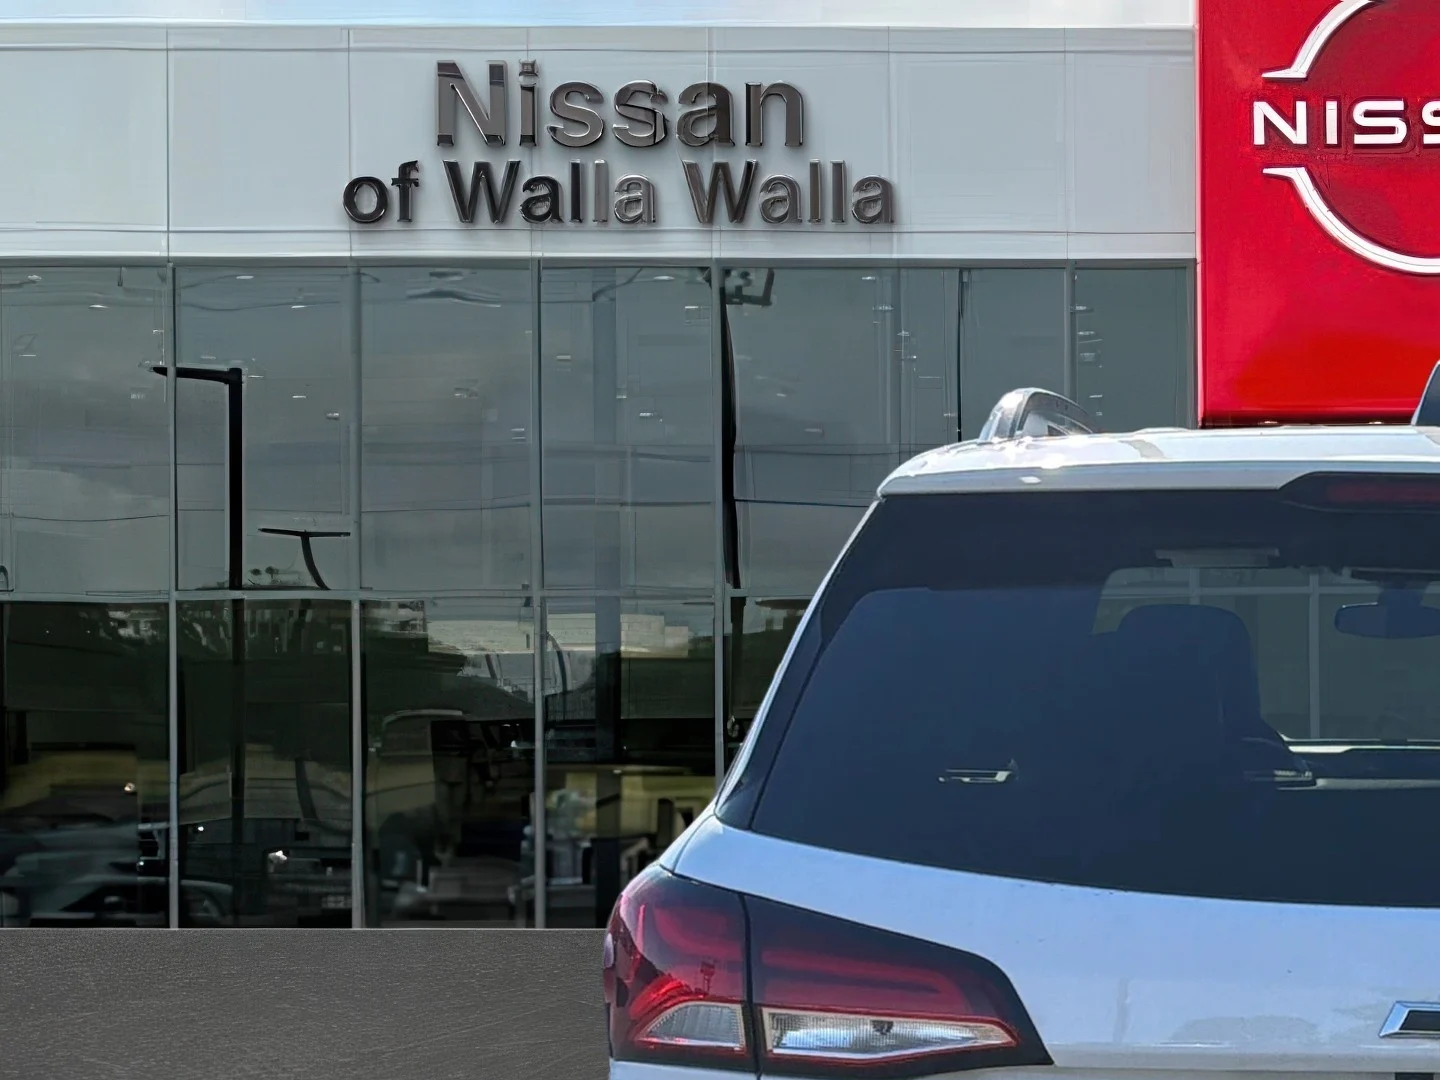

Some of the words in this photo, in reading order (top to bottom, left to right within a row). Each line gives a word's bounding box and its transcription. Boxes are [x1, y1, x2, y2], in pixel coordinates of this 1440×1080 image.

[435, 58, 804, 147] Nissan
[342, 159, 420, 224] of
[442, 159, 657, 225] Walla
[682, 159, 896, 225] Walla
